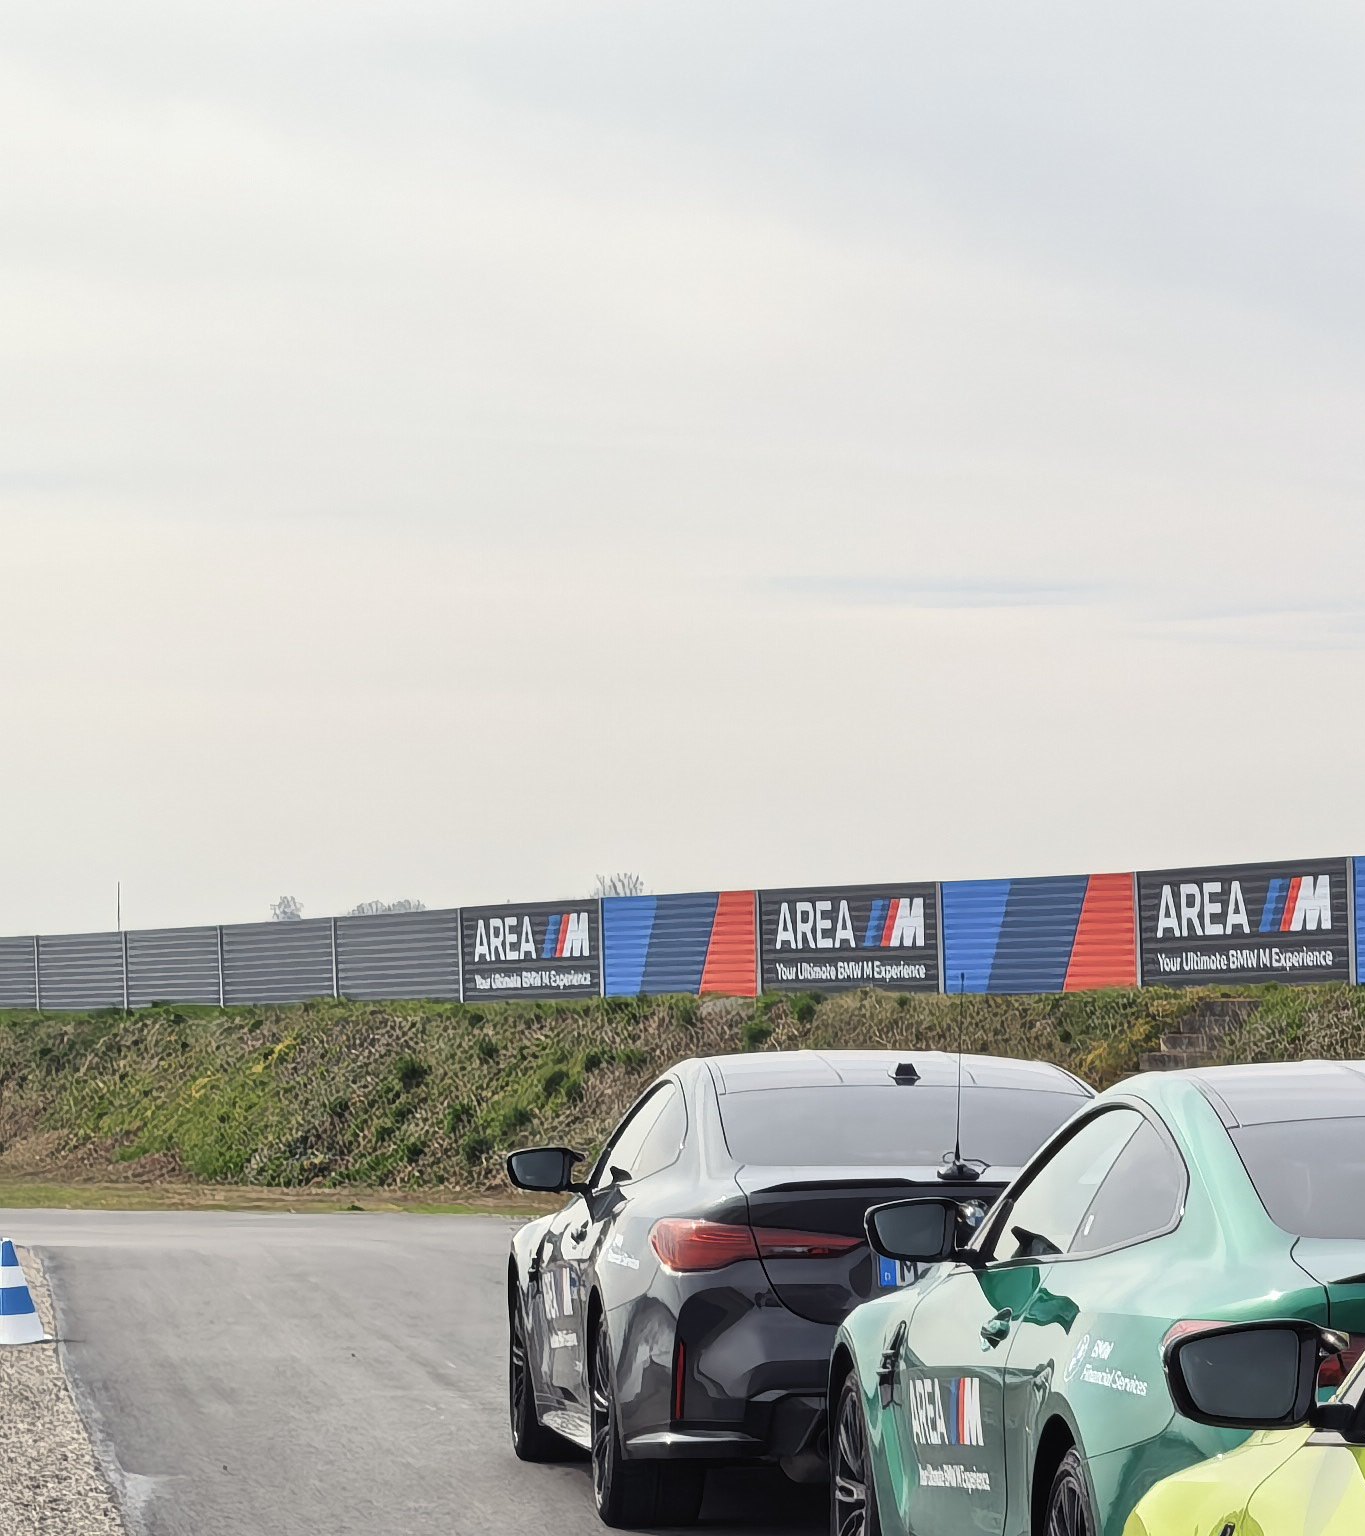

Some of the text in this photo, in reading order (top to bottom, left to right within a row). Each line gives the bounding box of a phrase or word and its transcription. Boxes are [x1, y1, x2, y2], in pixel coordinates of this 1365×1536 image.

[776, 900, 856, 949] AREA
[1157, 880, 1250, 938] AREA
[475, 916, 536, 962] AREA
[1157, 946, 1333, 972] Your Ultimate BMW M Experience
[776, 962, 796, 981] Your
[863, 960, 872, 979] M
[873, 960, 926, 982] Experience
[909, 1378, 948, 1445] AREA
